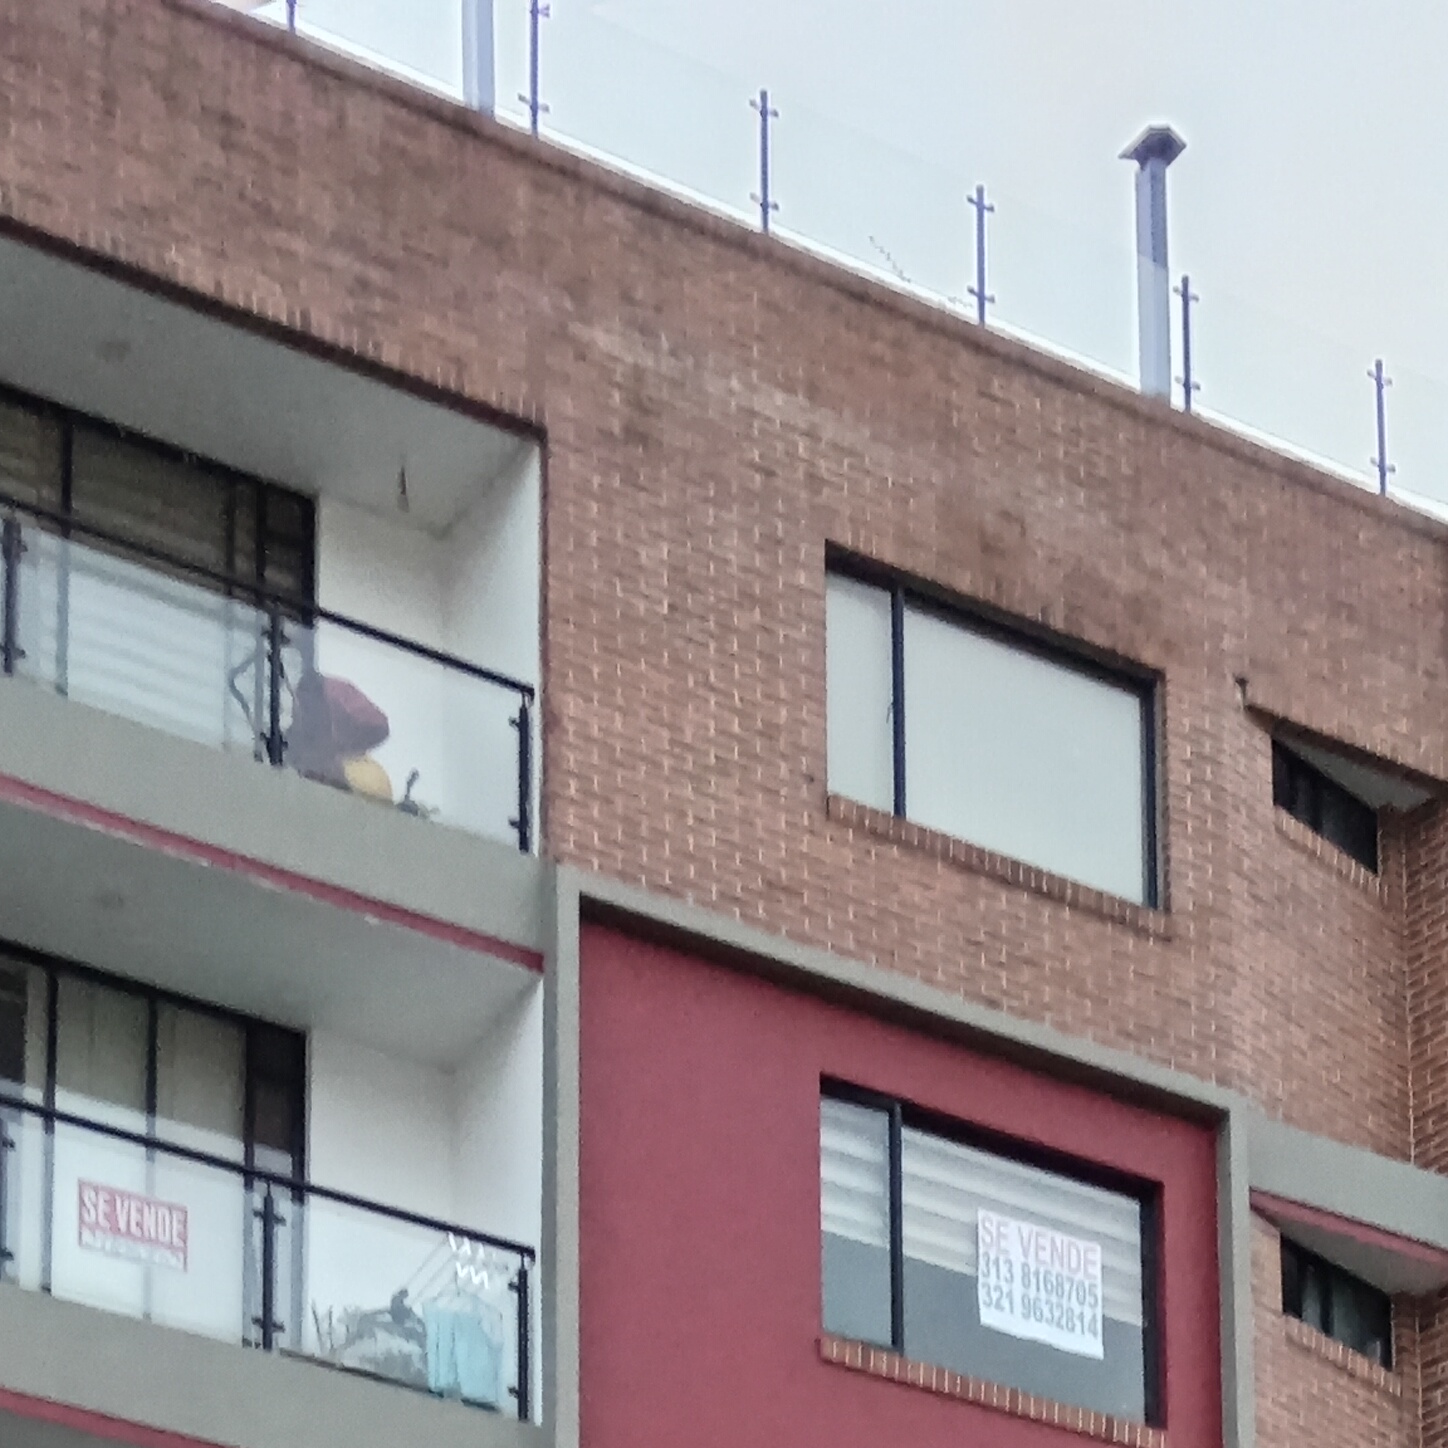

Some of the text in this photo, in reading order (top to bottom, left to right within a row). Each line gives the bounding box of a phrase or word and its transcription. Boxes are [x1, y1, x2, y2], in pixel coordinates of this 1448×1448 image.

[82, 1185, 110, 1230] SE
[114, 1193, 184, 1248] VENDE
[982, 1216, 1098, 1280] SE VENDE
[981, 1251, 1098, 1309] 313 8168705
[981, 1281, 1014, 1315] 321
